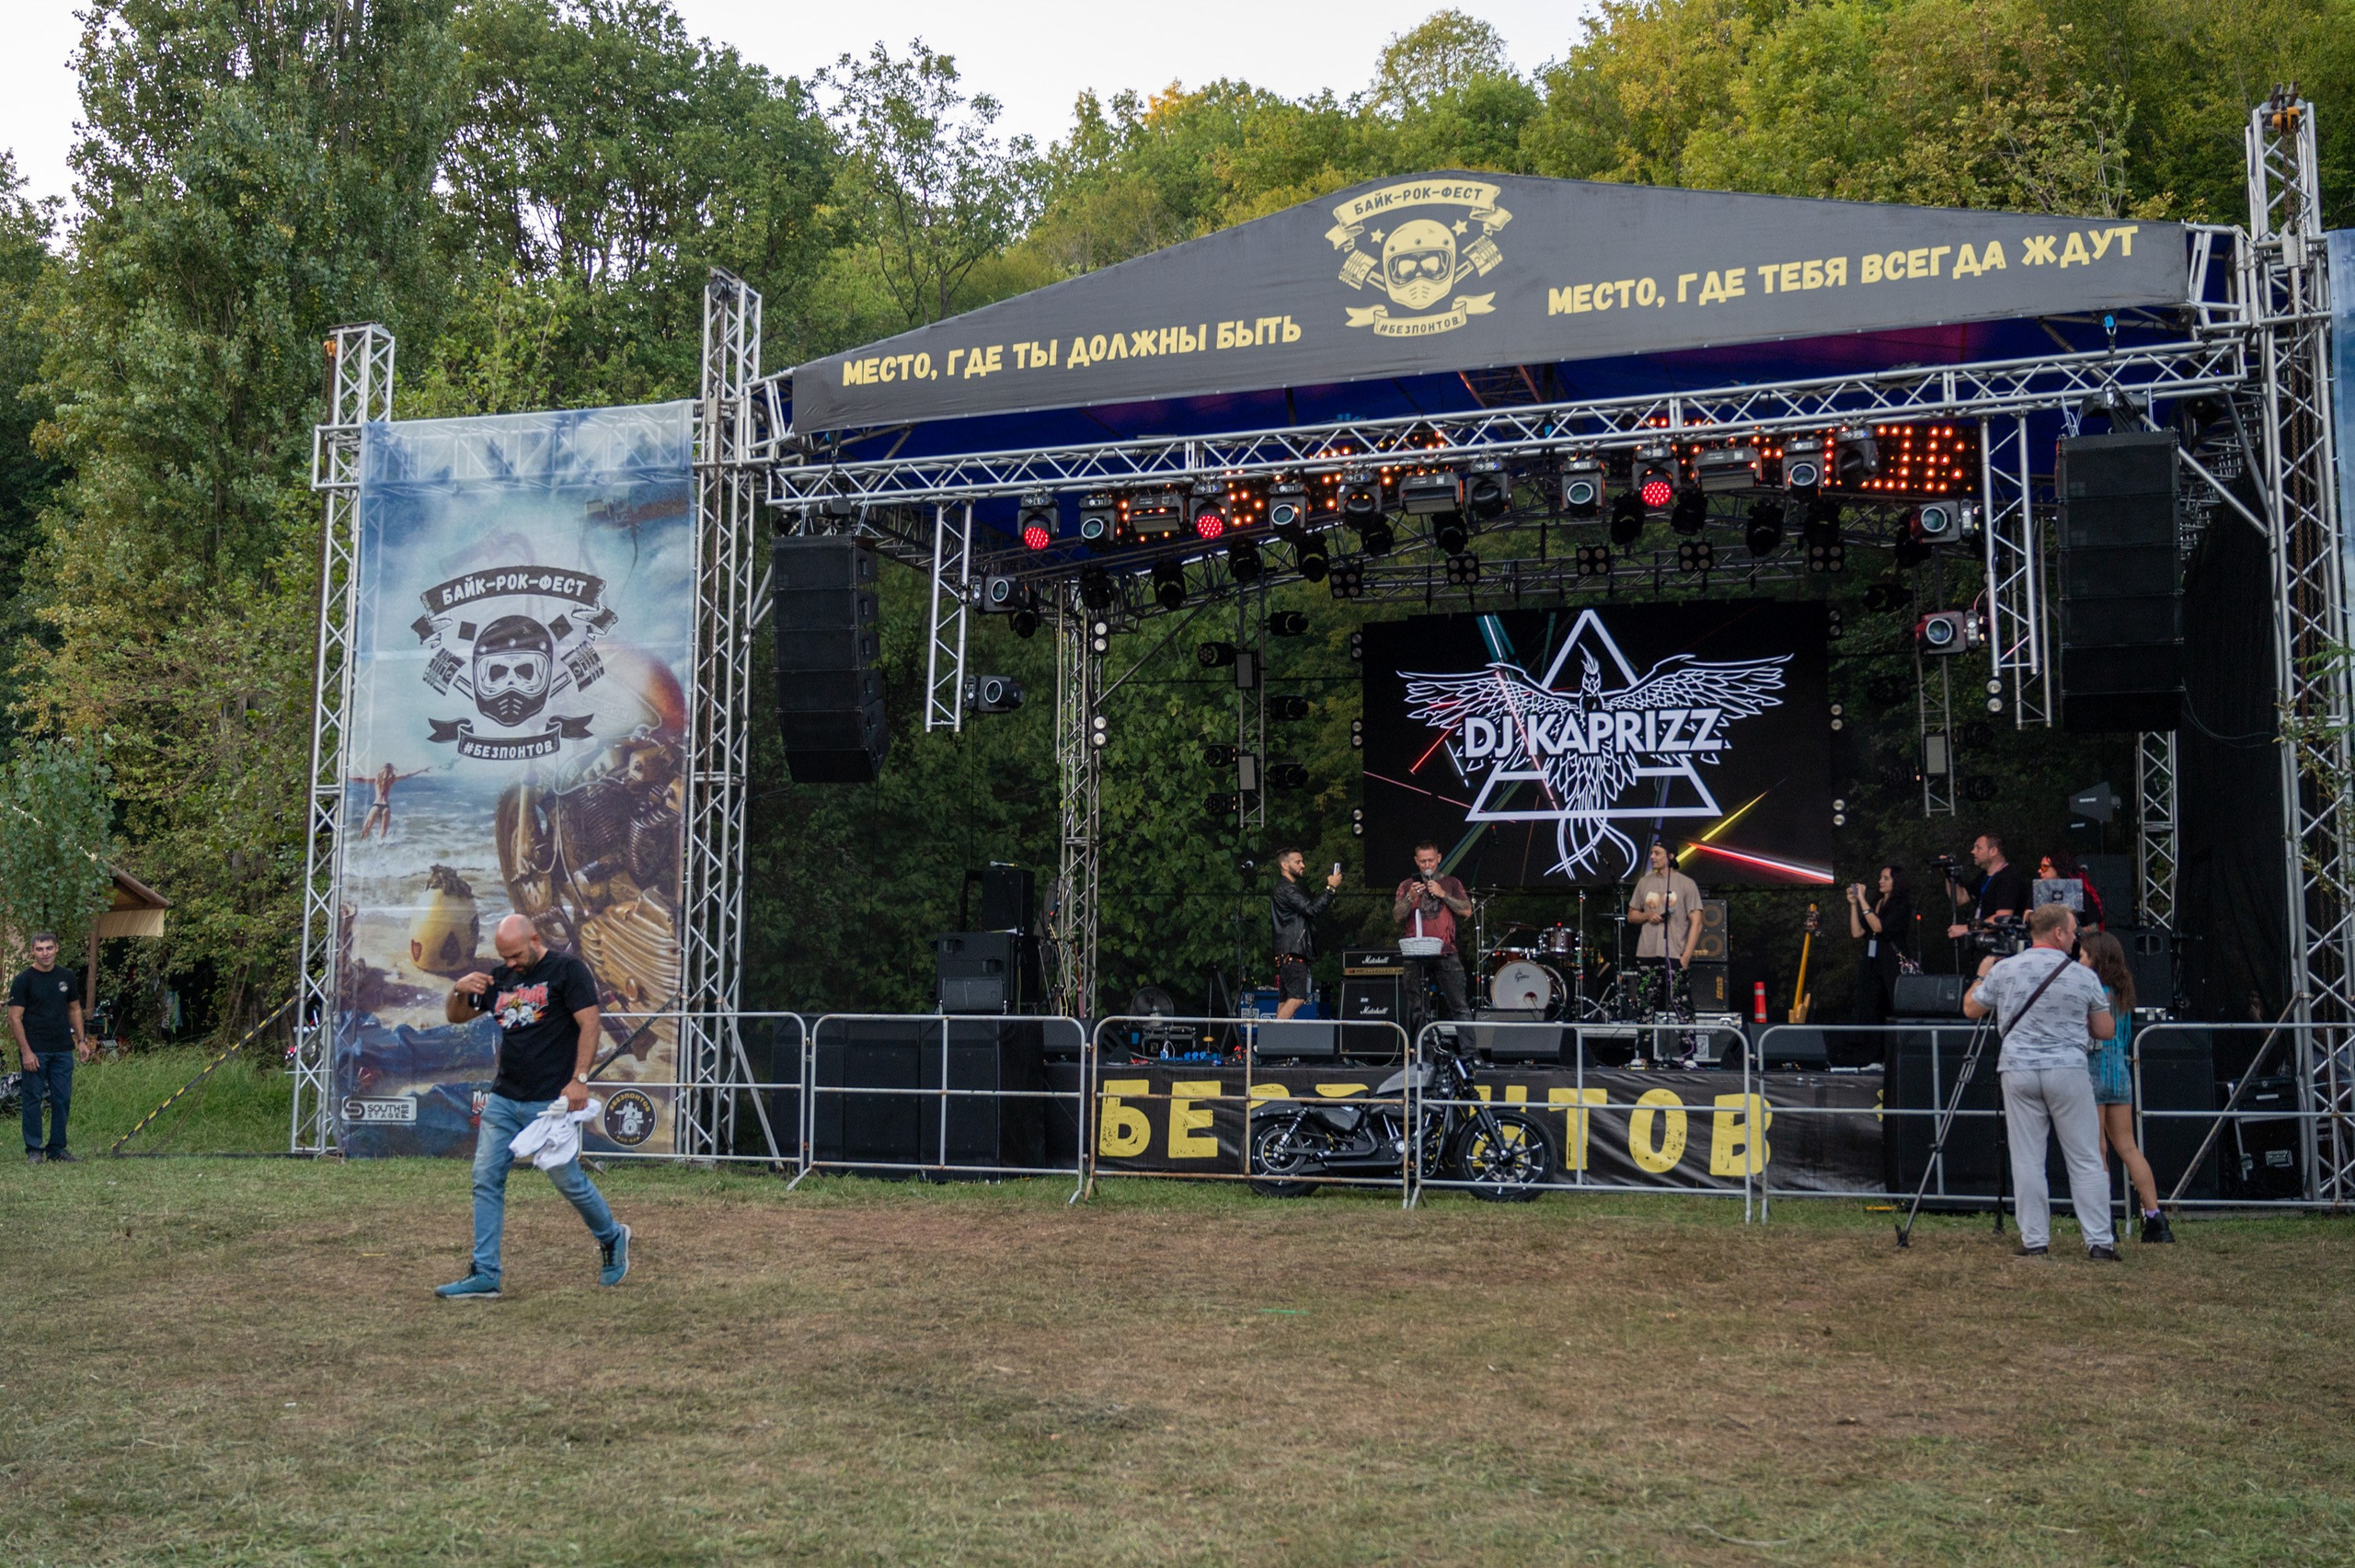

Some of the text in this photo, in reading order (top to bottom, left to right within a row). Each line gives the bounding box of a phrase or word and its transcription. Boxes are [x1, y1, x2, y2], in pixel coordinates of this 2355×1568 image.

[1354, 186, 1483, 216] БАЙК-РОК-ФЕСТ
[1548, 226, 2139, 315] МЕСТО, ГДЕ ТЕБЯ ВСЕГДА ЖДУТ
[1380, 315, 1459, 334] #БЕЗПОНТОВ
[843, 315, 1302, 387] МЕСТО, ГДЕ ТЫ ДОЛЖНЫ БЫТЬ
[442, 573, 587, 606] БАЙК-РОК-ФЕСТ
[463, 739, 554, 759] #БЕЗПОНТОВ
[1465, 708, 1722, 759] DJ KAPRIZZ
[367, 1104, 409, 1119] SOUTH PRO
